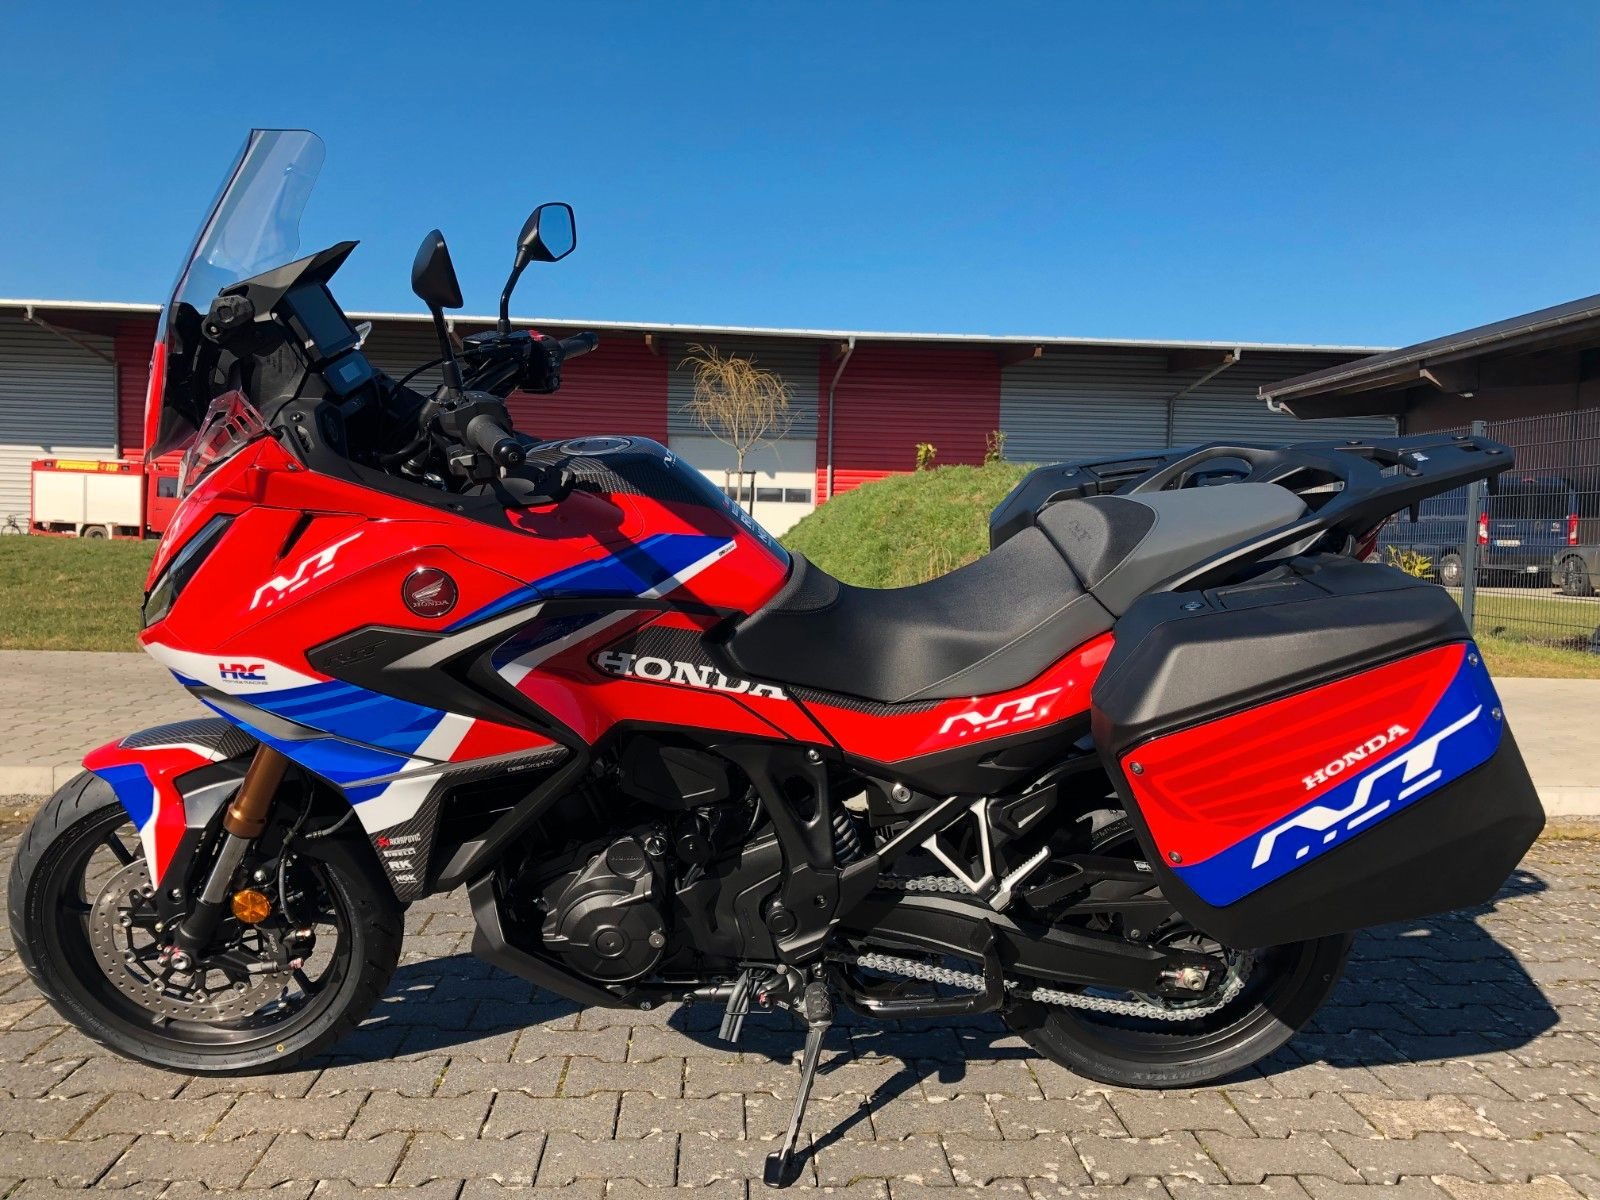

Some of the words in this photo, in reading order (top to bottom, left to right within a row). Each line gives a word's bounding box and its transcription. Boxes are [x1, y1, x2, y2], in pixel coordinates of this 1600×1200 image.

[412, 599, 450, 608] HONDA
[218, 662, 266, 681] HRC
[597, 650, 789, 701] HONDA
[1302, 723, 1410, 791] HONDA
[388, 859, 413, 870] RK
[394, 873, 417, 883] NGK
